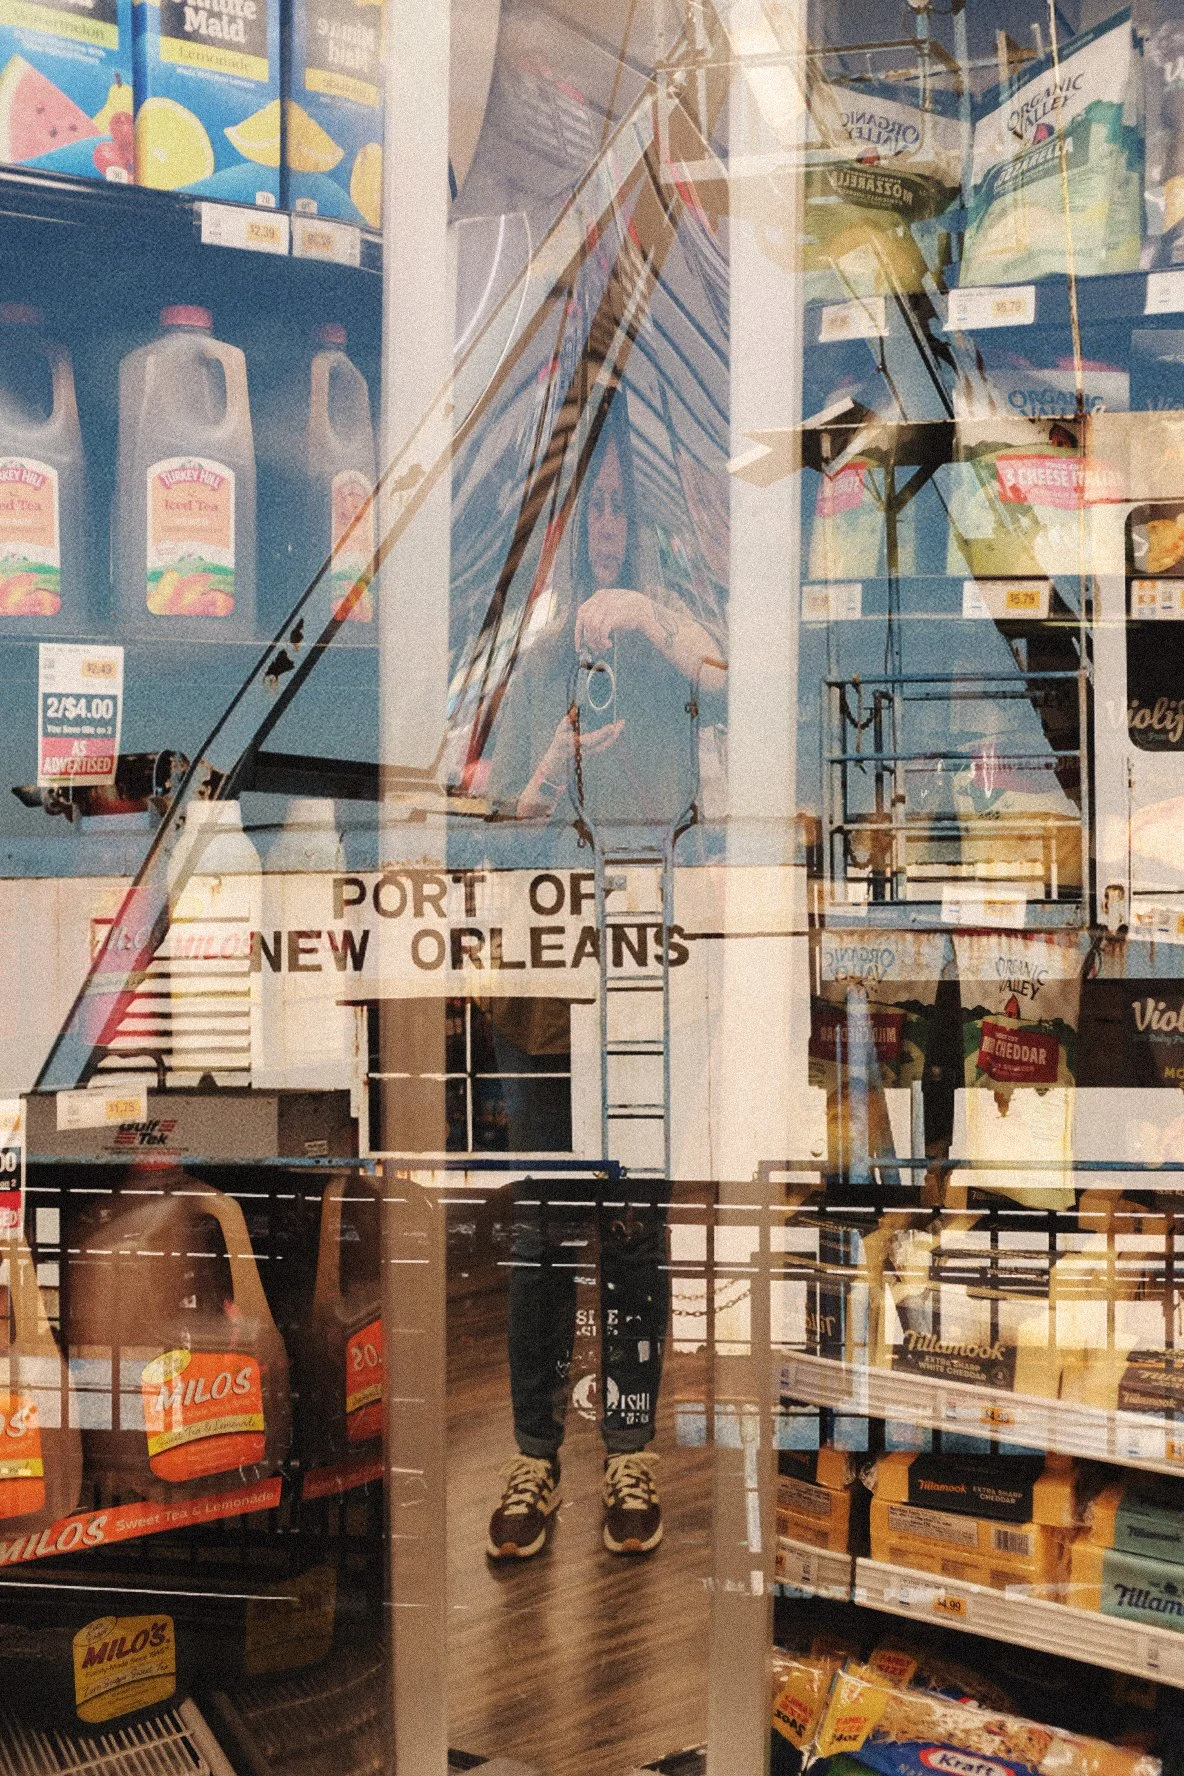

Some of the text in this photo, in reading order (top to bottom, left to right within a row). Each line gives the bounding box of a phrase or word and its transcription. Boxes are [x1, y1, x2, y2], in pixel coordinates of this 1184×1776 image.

[184, 7, 246, 44] Maid
[1007, 73, 1085, 132] ORGANIC
[162, 470, 199, 486] TURKEY
[1017, 468, 1069, 486] CHEESE
[46, 696, 114, 720] 2/$4.00
[71, 740, 87, 756] AS
[43, 754, 111, 774] ADVERTISED
[333, 872, 612, 919] PORT OF
[251, 924, 690, 973] NEW ORLEANS
[995, 1041, 1047, 1065] CHEDDAR
[903, 1329, 1006, 1361] Tillamook
[917, 1478, 967, 1494] Tillamook
[979, 1492, 1017, 1505] CHEDDAR
[115, 1513, 161, 1533] Sweet
[165, 1509, 188, 1522] Tea
[204, 1490, 275, 1515] Lemonade
[1127, 1525, 1182, 1543] Tillamook
[939, 1752, 995, 1776] Kraft
